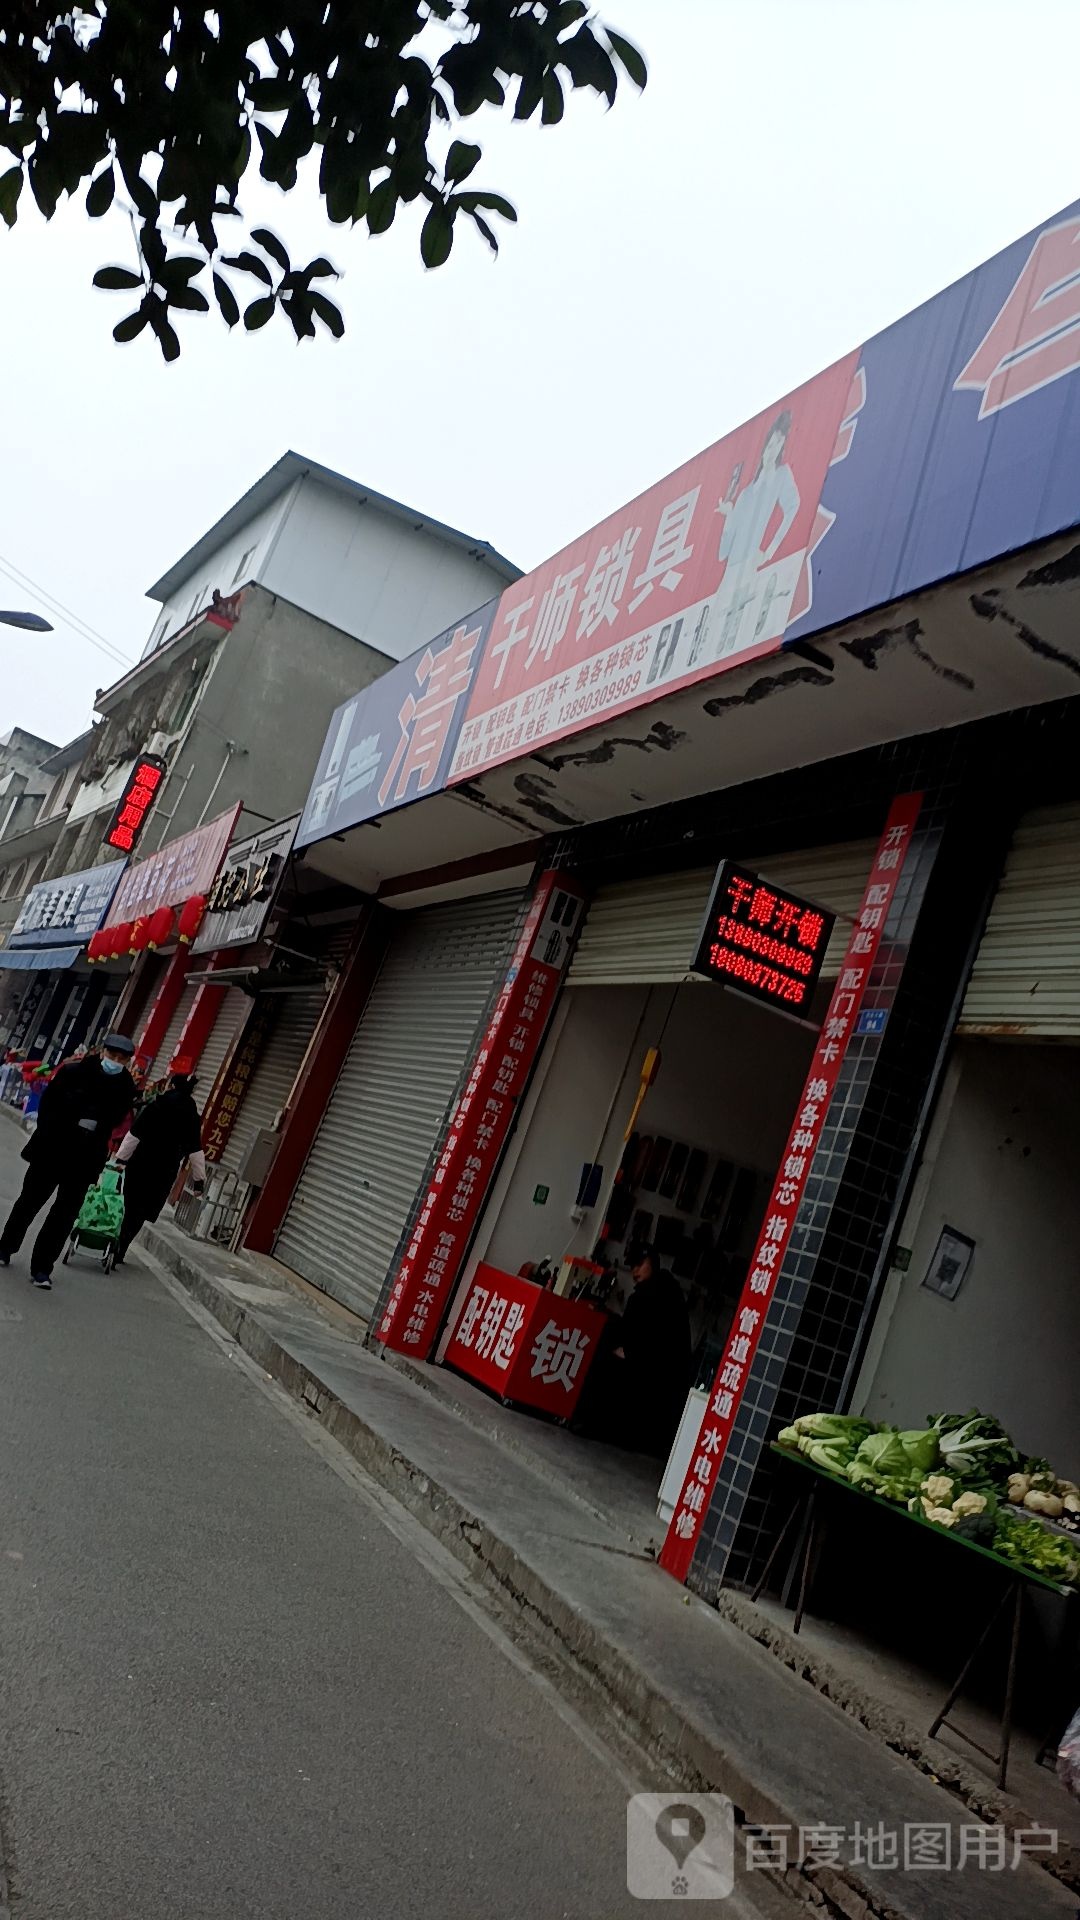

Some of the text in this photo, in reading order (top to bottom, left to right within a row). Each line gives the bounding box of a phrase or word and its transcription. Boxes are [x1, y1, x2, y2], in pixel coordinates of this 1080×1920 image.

[491, 484, 702, 690] 干师锁具
[574, 634, 654, 692] 换各种锁芯
[377, 624, 483, 808] 清
[557, 670, 642, 725] 13890309989
[109, 762, 163, 852] 酒店用品
[507, 1023, 530, 1054] 开锁
[491, 1054, 519, 1096] 配钥匙
[472, 1097, 504, 1151] 配门禁卡
[446, 1154, 483, 1223] 换各种锁芯
[674, 824, 909, 1541] 开锁 配钥匙 配门禁卡 换各种锁芯 指纹锁 管道疏通 水电维修
[422, 1230, 457, 1289] 管道疏通
[402, 1289, 435, 1345] 水电维修
[455, 1284, 526, 1371] 配钥匙
[530, 1318, 592, 1393] 锁
